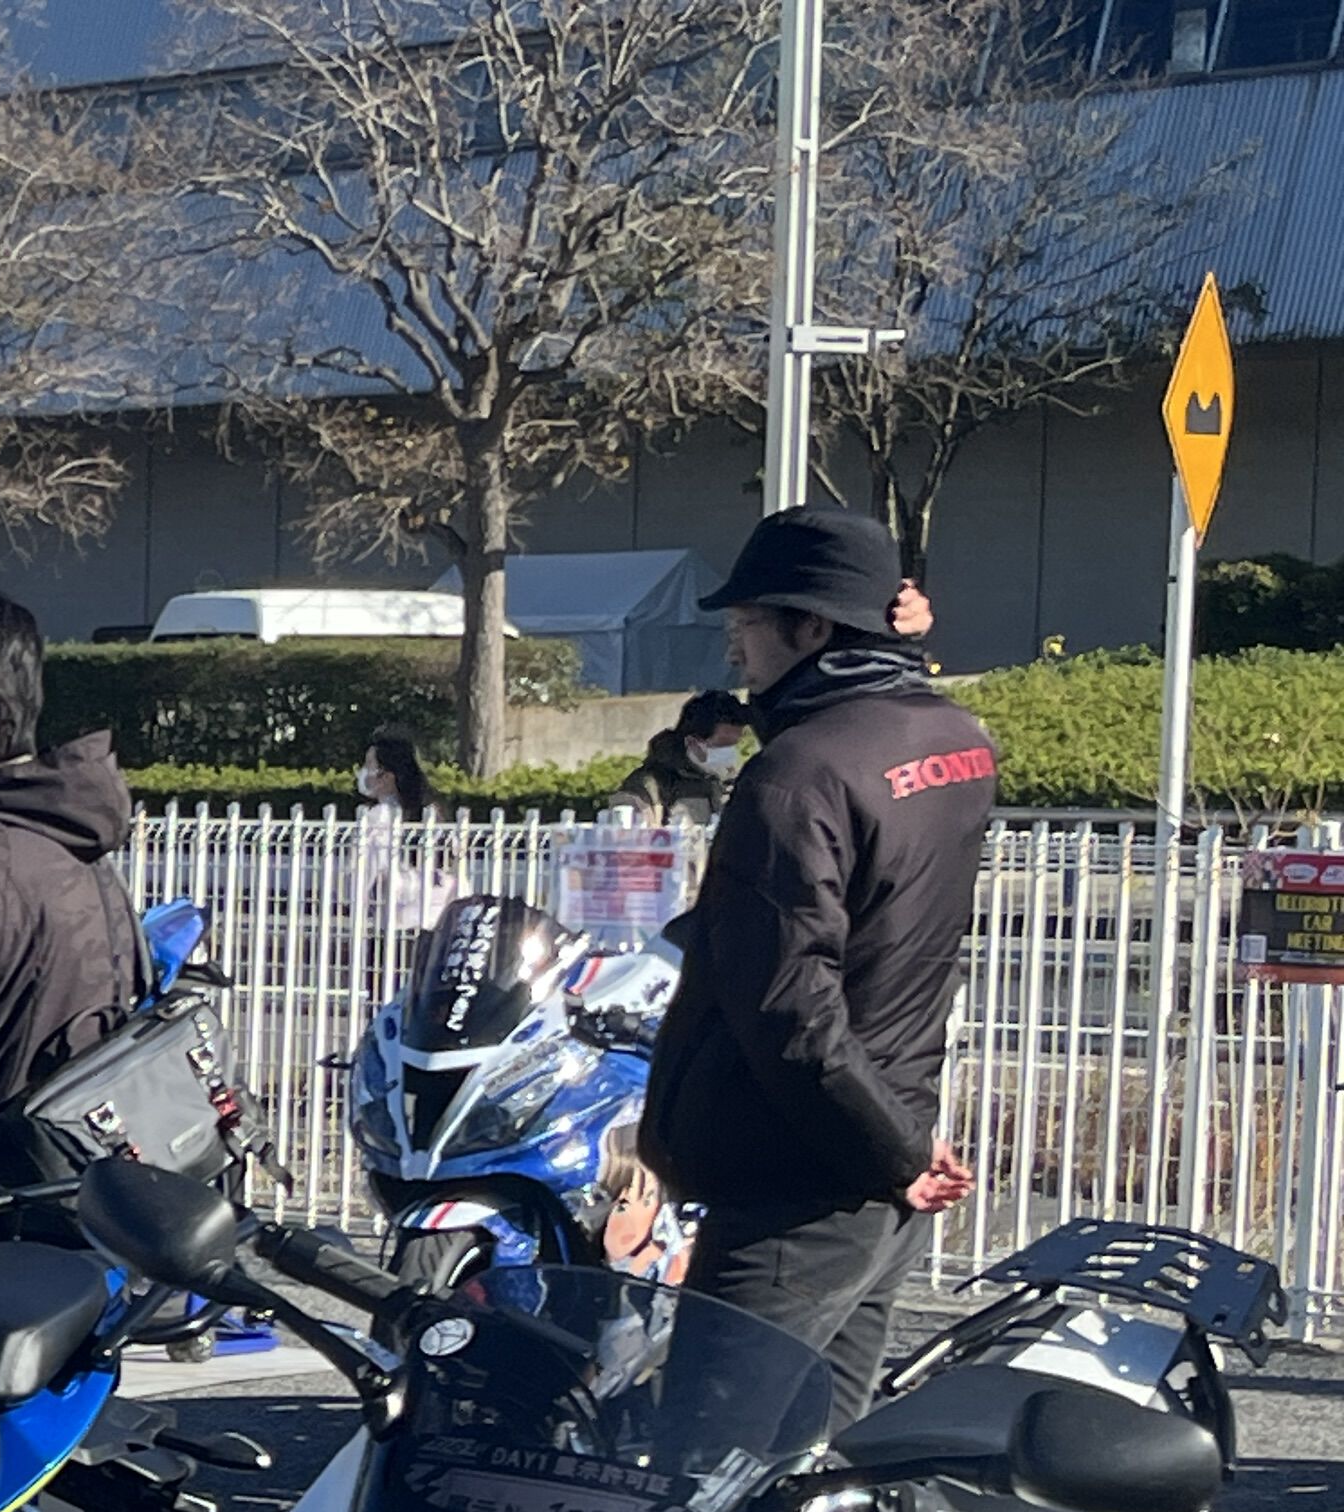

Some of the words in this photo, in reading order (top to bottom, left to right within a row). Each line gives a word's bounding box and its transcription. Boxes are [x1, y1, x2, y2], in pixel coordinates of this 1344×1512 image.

[884, 747, 996, 800] HOND
[491, 1445, 548, 1473] DAY1
[553, 1456, 673, 1497] 展示許可証
